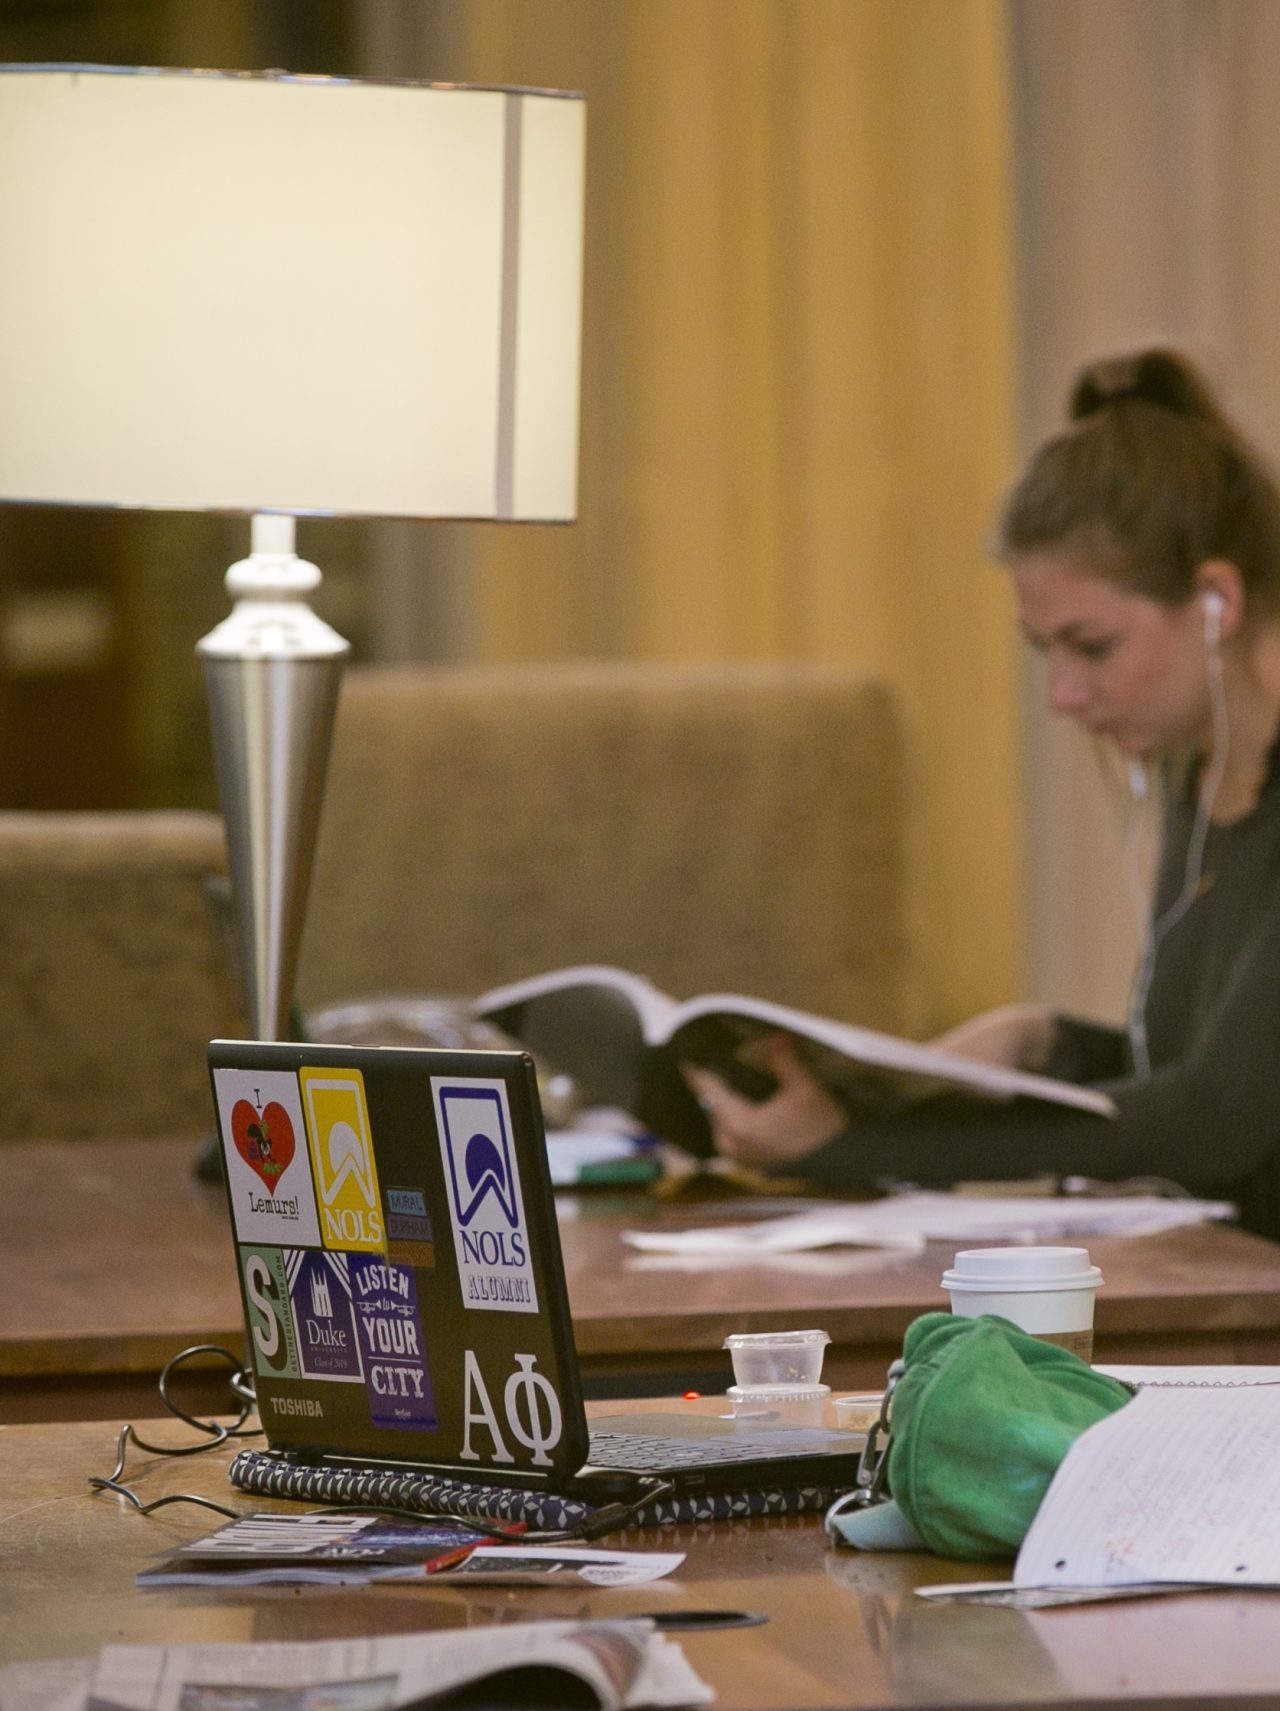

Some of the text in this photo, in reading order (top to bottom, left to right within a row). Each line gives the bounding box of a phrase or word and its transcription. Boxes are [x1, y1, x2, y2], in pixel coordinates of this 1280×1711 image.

[254, 1088, 262, 1109] I
[248, 1192, 300, 1215] Lemurs!
[323, 1207, 382, 1244] NOLS
[460, 1230, 526, 1267] NOLS
[356, 1264, 409, 1299] LISTEN
[468, 1275, 531, 1303] ALUMNI
[306, 1319, 347, 1347] Duke
[362, 1316, 420, 1356] YOUR
[371, 1365, 424, 1398] CITY
[270, 1397, 324, 1418] TOSHIBA
